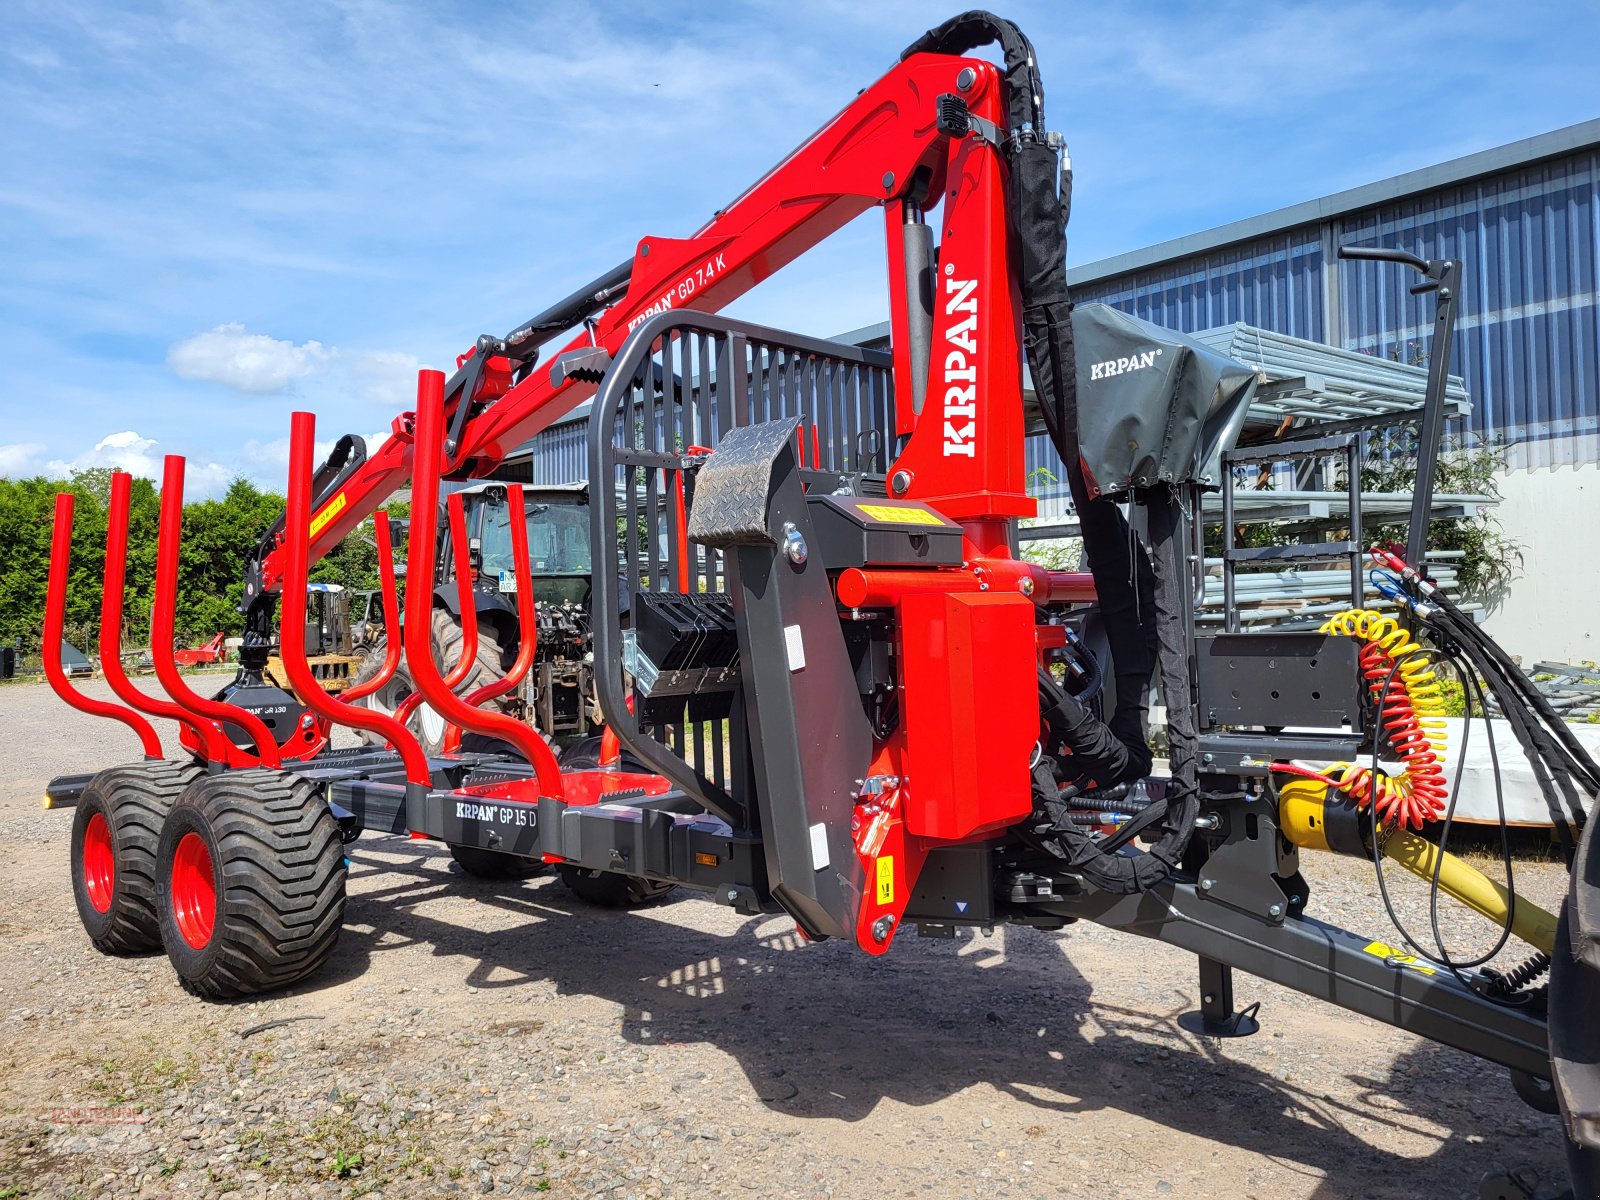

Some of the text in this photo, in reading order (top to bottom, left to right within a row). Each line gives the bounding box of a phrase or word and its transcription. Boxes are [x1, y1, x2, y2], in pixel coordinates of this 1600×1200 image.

[678, 277, 695, 300] GD
[696, 261, 714, 286] 7,4
[716, 252, 726, 272] K
[500, 808, 514, 825] GP
[515, 810, 527, 827] 15
[529, 811, 537, 827] D
